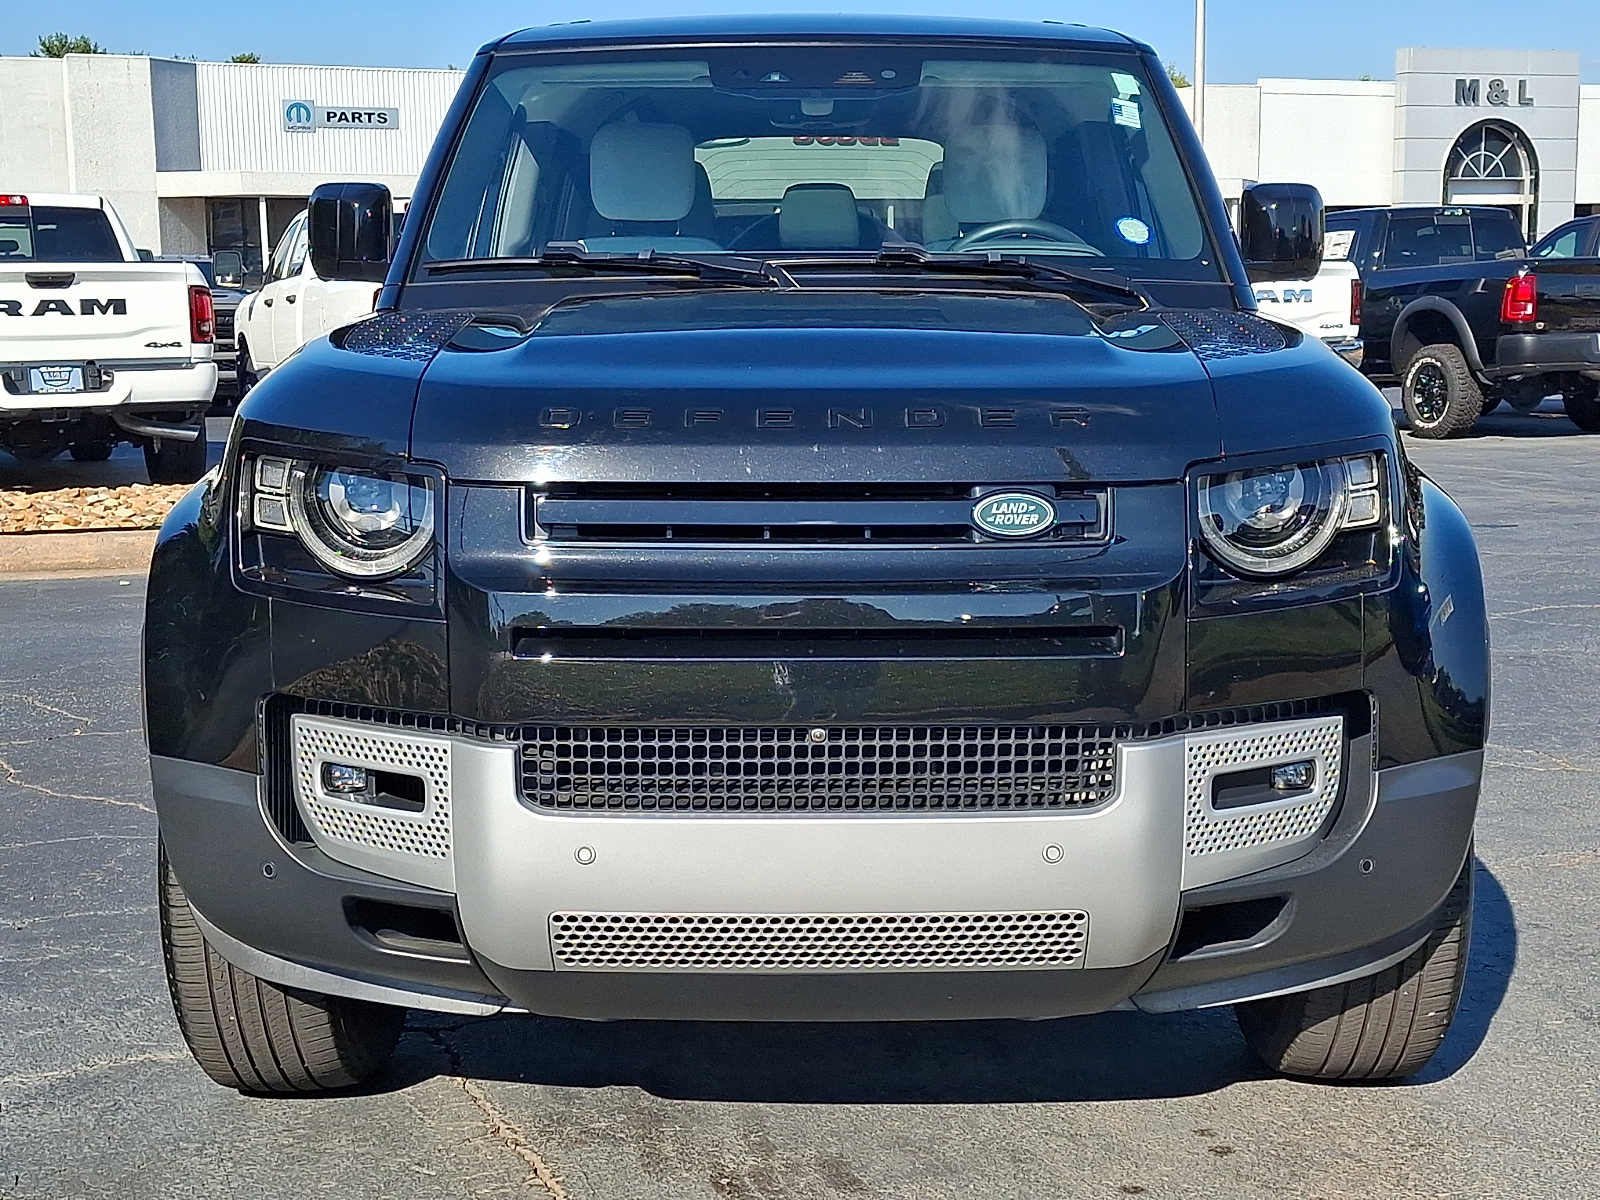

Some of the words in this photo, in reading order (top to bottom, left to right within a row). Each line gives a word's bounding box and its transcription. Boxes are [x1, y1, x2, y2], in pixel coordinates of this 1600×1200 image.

[1455, 78, 1480, 106] M
[1486, 78, 1509, 106] &
[1518, 79, 1534, 107] L
[326, 111, 388, 124] PARTS
[0, 298, 127, 317] RAM
[539, 405, 1092, 429] DEFENDER
[991, 502, 1028, 514] LAND
[994, 513, 1040, 525] ROVER
